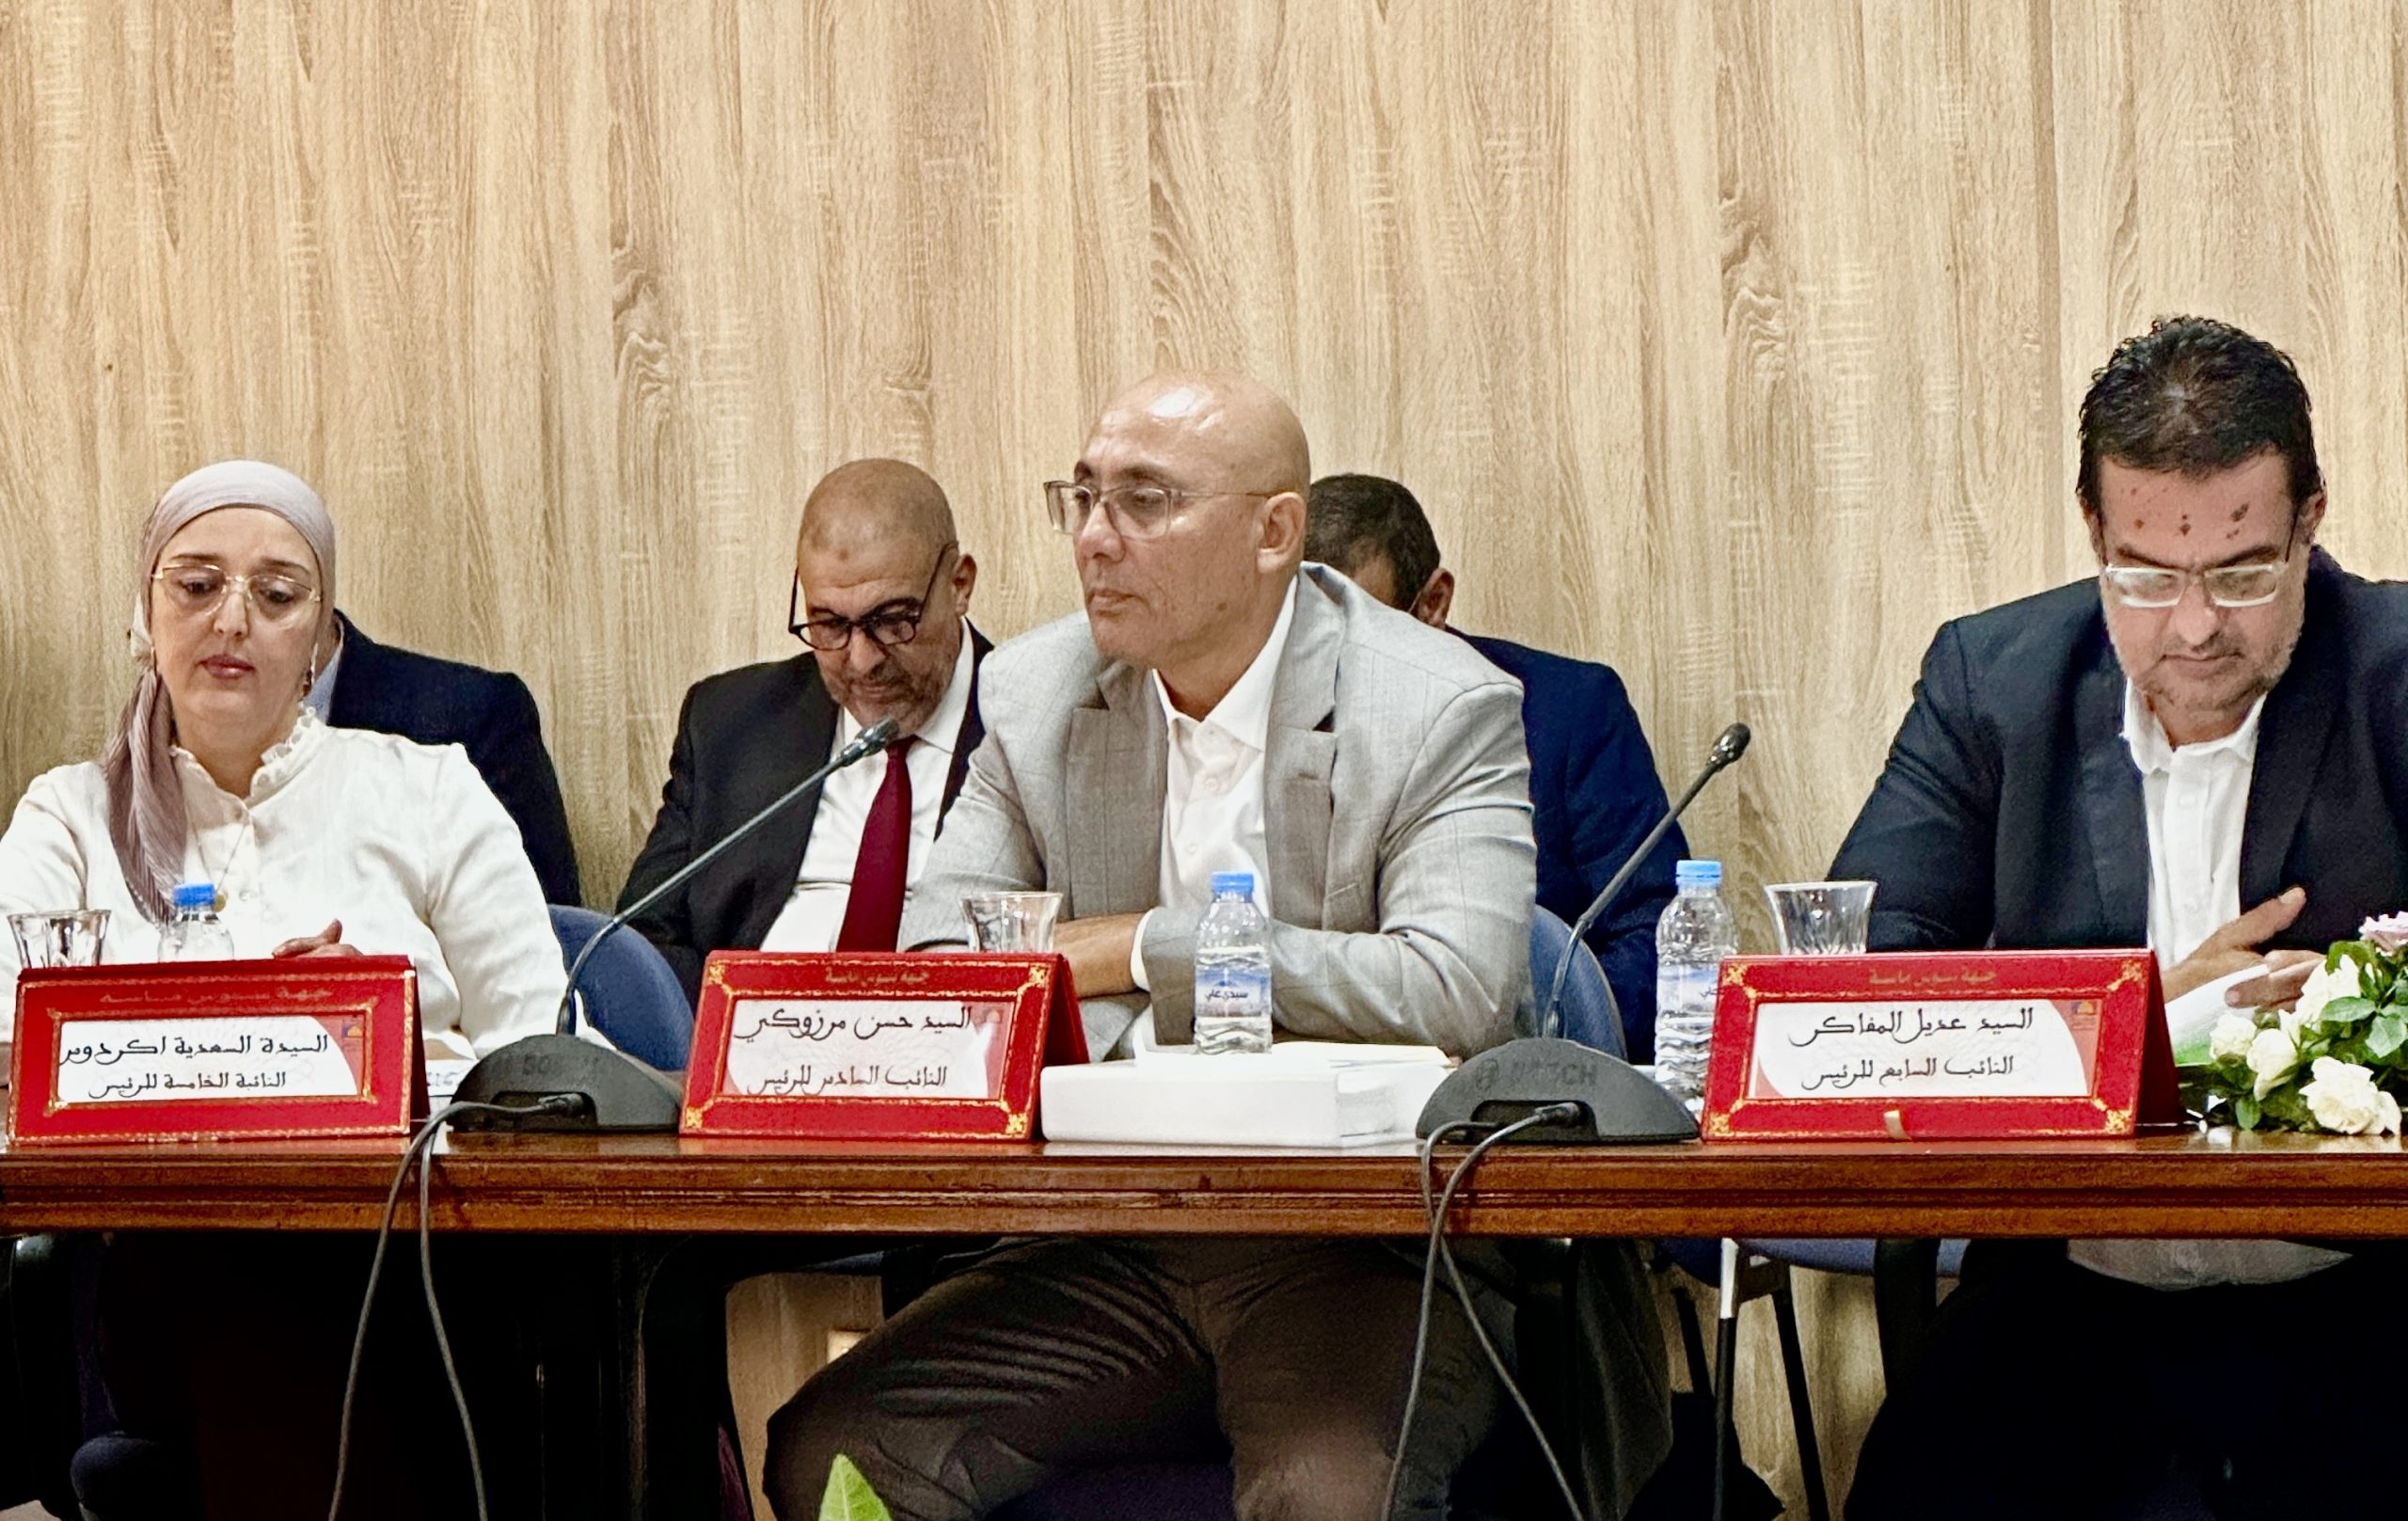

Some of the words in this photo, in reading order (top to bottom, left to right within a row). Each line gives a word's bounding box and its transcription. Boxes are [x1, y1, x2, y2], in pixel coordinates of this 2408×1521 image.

[734, 1008, 846, 1043] مرزوكي
[854, 1016, 913, 1039] حسن
[920, 1006, 973, 1034] السيد
[1977, 1006, 2034, 1035] السيد
[174, 1035, 251, 1058] السعدية
[260, 1034, 328, 1057] السيدة
[164, 1072, 229, 1089] الخامسة
[747, 1064, 812, 1096] للرئيس
[801, 1065, 879, 1096] السادس
[885, 1065, 947, 1089] النائب
[1801, 1059, 1873, 1091] للرئيس
[1879, 1057, 1937, 1087] السابع
[1944, 1055, 2014, 1079] النائب
[88, 1072, 157, 1099] للرئيس
[235, 1071, 286, 1091] النائبة
